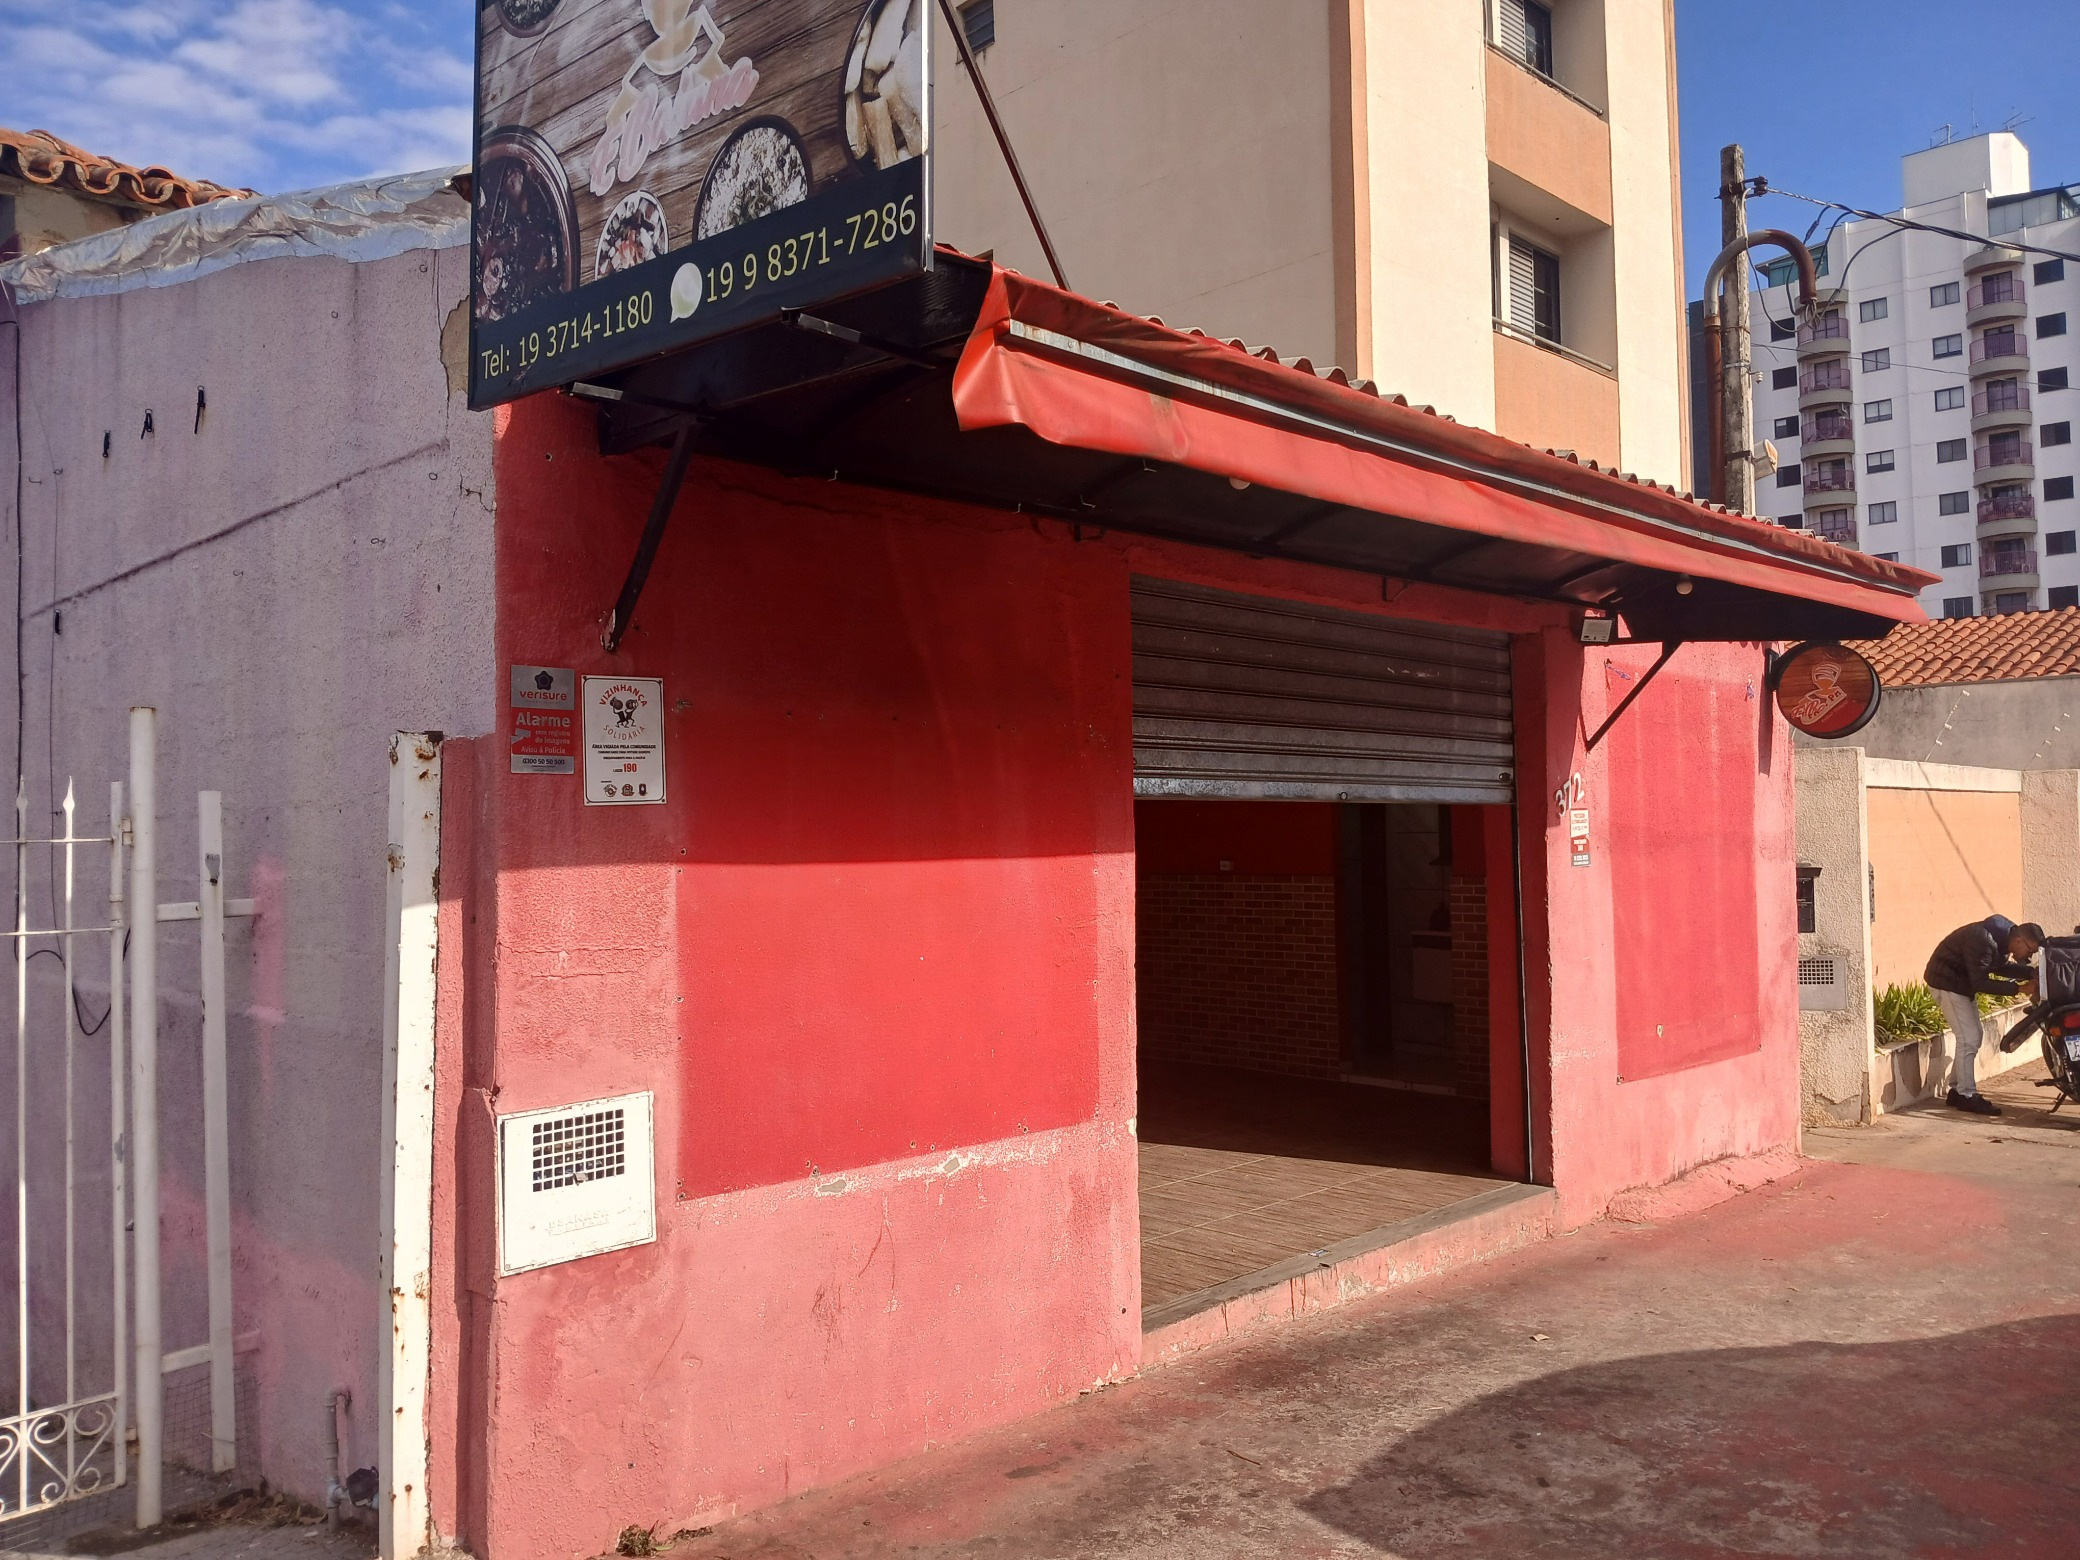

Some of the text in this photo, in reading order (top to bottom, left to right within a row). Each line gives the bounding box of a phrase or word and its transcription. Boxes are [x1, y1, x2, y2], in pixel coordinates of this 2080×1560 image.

[706, 194, 917, 303] 19 9 8371-7286
[481, 290, 653, 380] Tel: 19 3714-1180
[519, 690, 568, 701] verisure
[599, 684, 648, 707] VIZINHANÇA
[516, 711, 571, 728] Alarme
[623, 763, 637, 773] 190
[1556, 771, 1585, 817] 372
